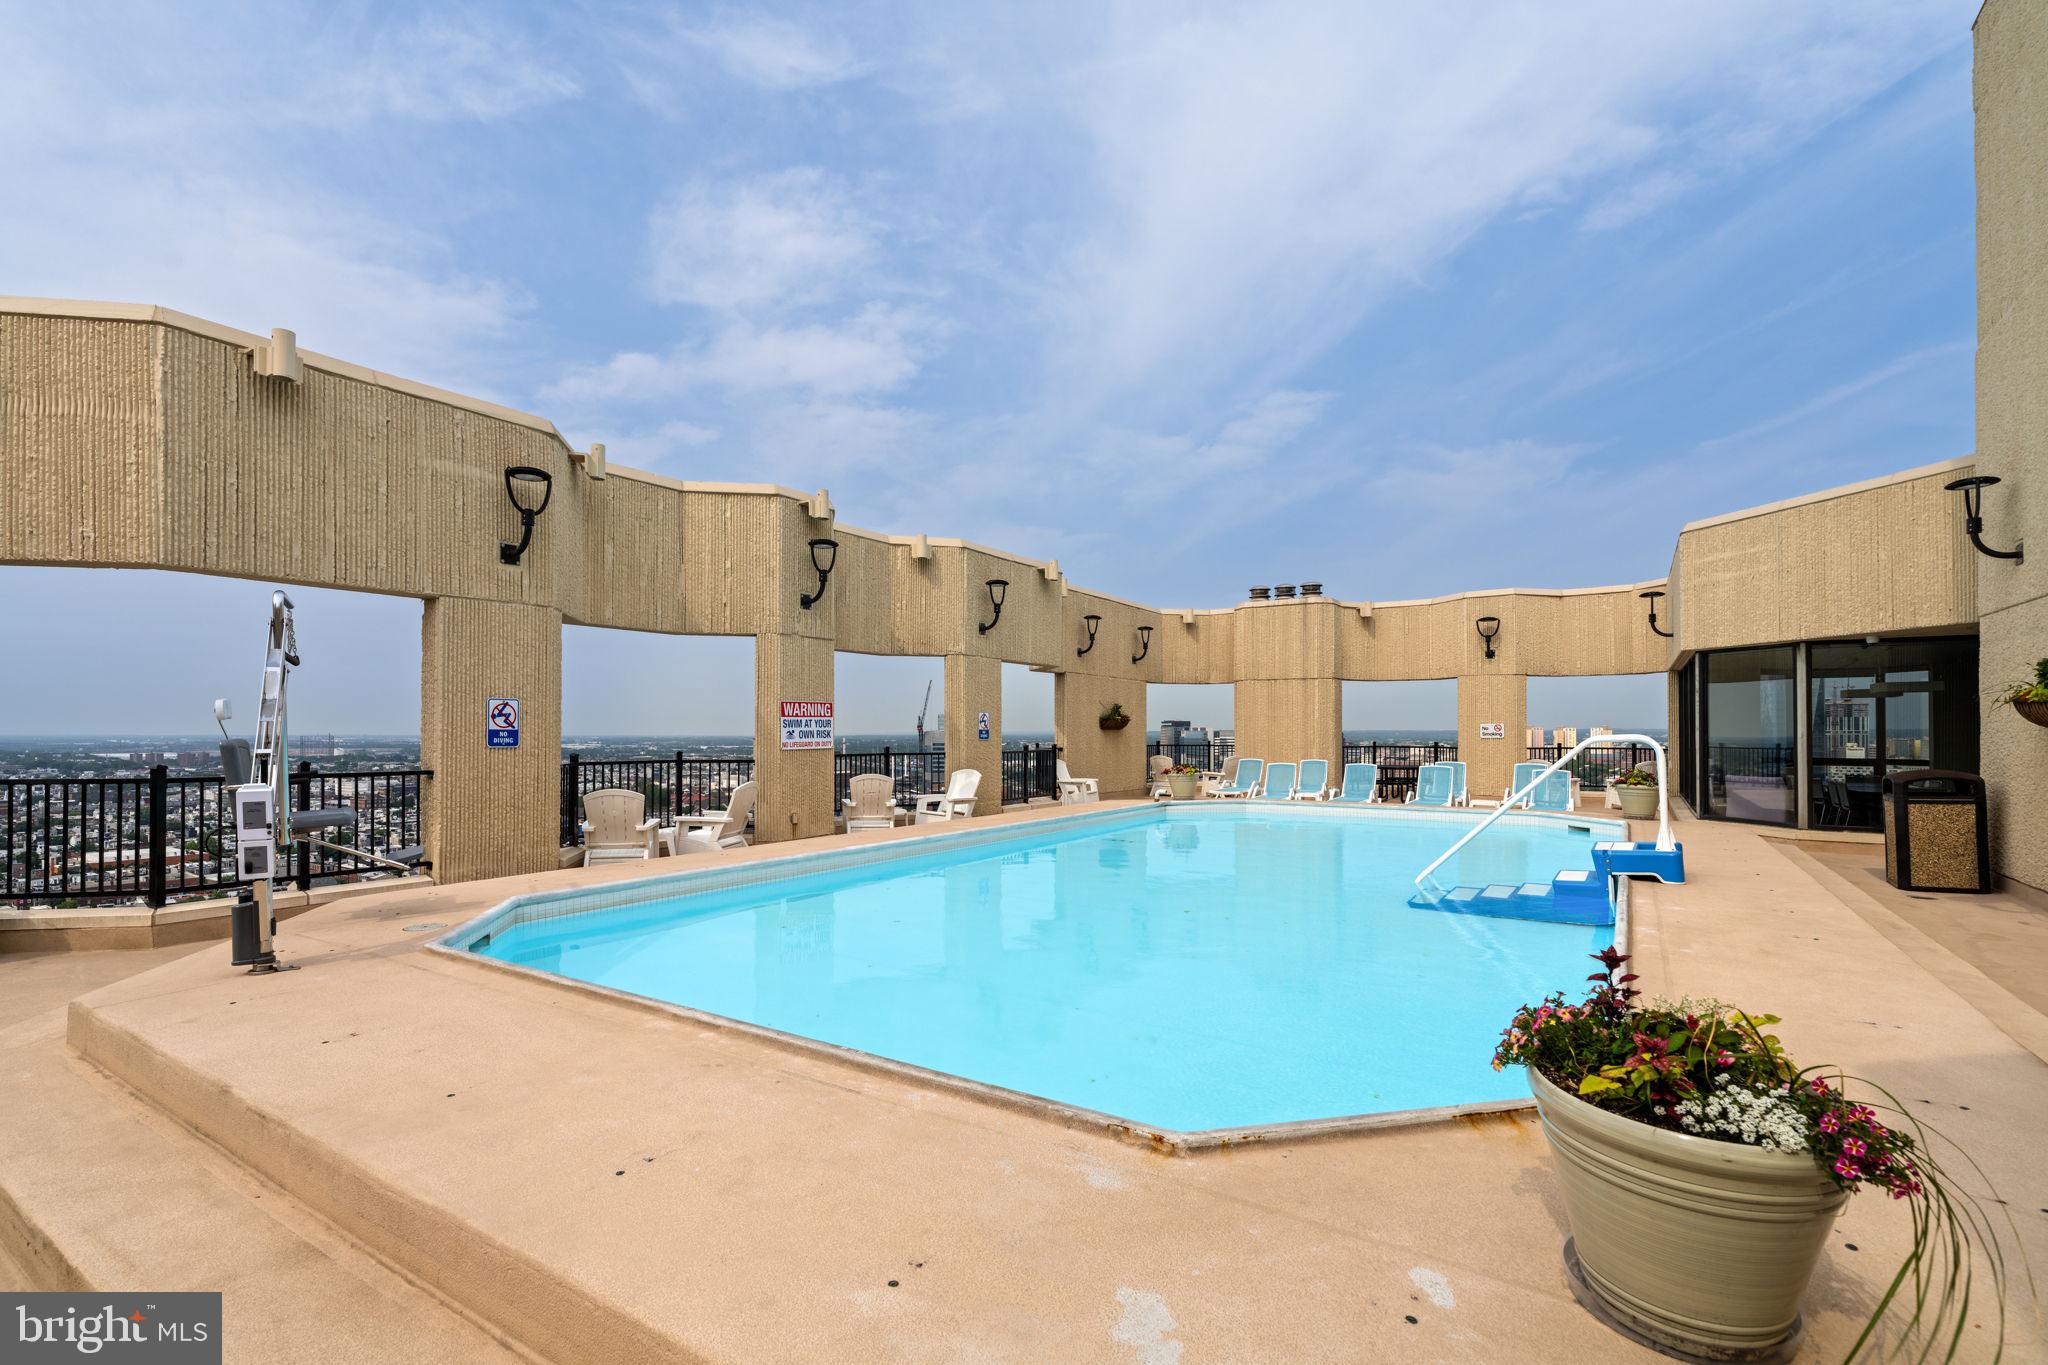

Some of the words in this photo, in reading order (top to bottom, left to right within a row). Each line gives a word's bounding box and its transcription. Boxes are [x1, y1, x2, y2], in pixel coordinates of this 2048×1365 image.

[783, 702, 831, 716] WARNING
[782, 718, 803, 728] SWIM
[804, 719, 813, 728] AT
[814, 719, 832, 728] YOUR
[798, 730, 815, 739] OWN
[816, 730, 832, 739] RISK
